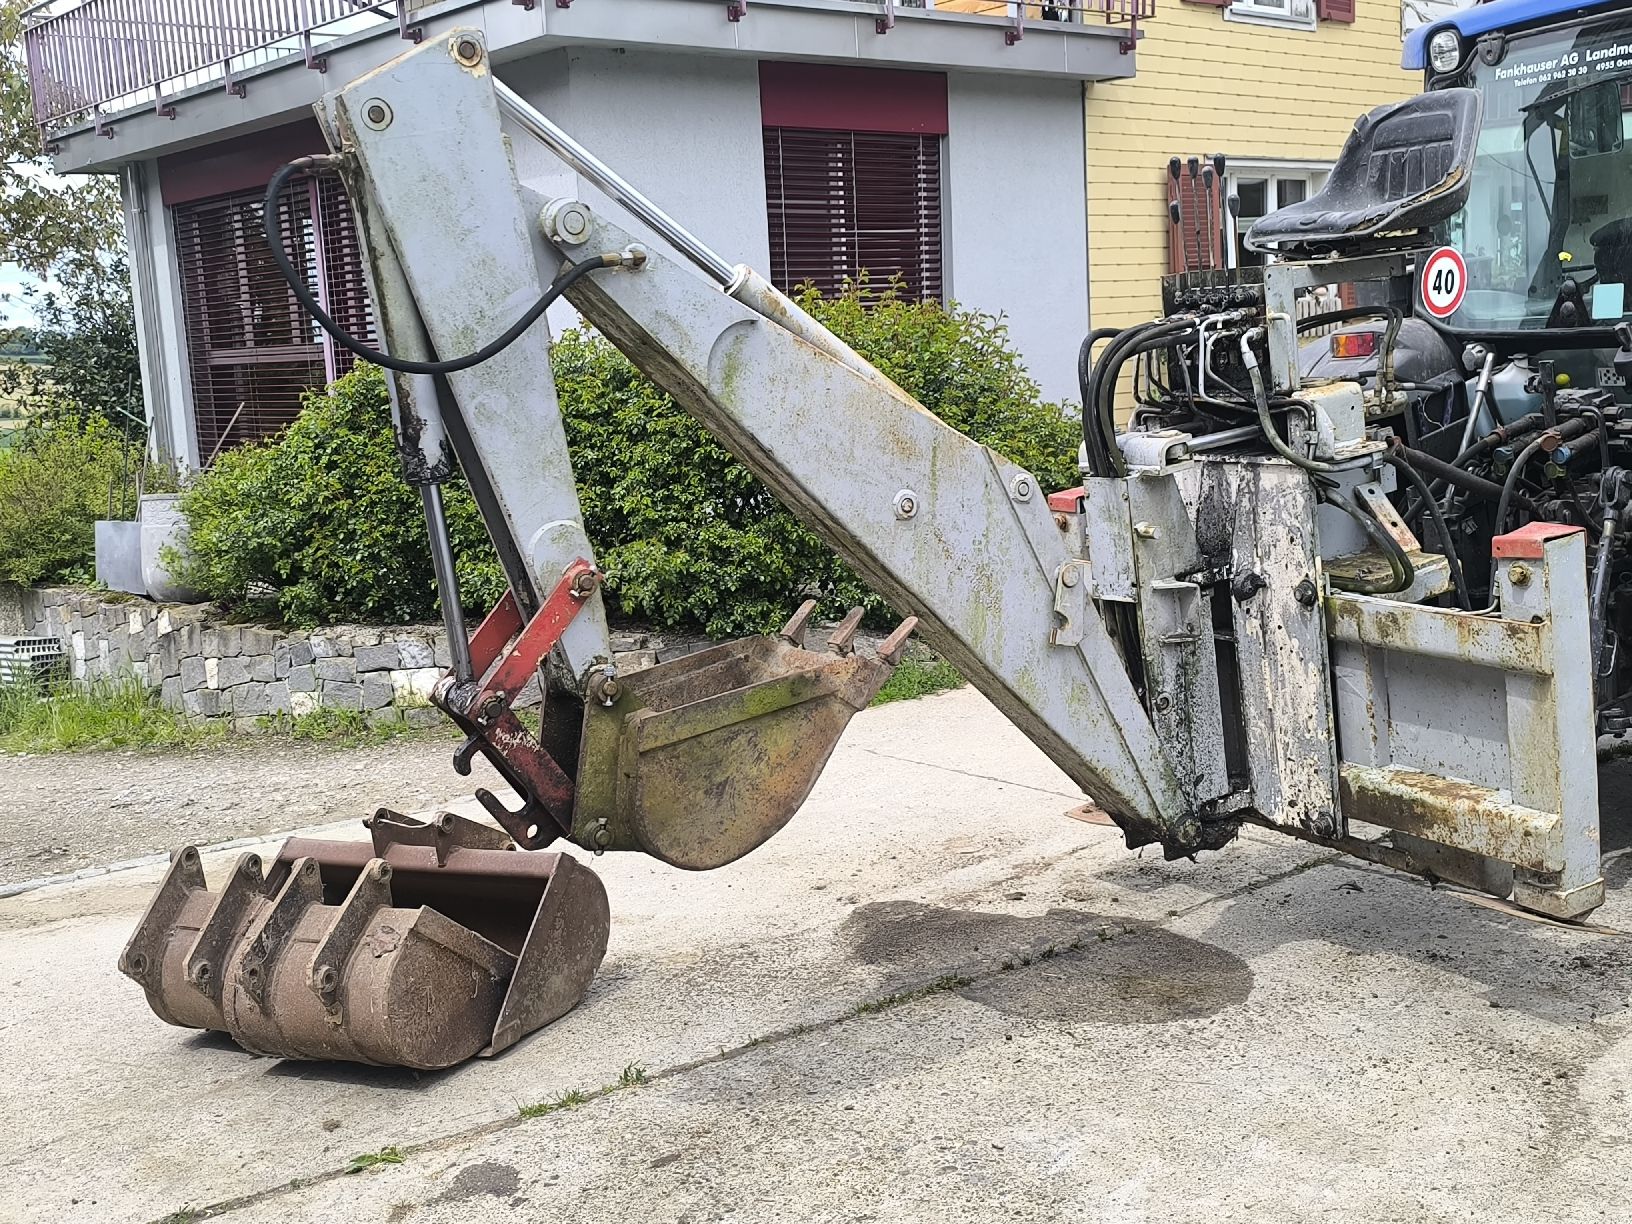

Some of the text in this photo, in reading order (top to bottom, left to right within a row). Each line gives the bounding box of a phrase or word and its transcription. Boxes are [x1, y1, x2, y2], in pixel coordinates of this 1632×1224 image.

[1495, 59, 1559, 81] Fankhauser
[1560, 52, 1579, 67] AG
[1513, 77, 1538, 88] Telefon
[1538, 73, 1552, 83] 062
[1553, 69, 1567, 80] 962
[1567, 67, 1577, 77] 30
[1578, 65, 1588, 75] 30
[1432, 269, 1455, 295] 40
